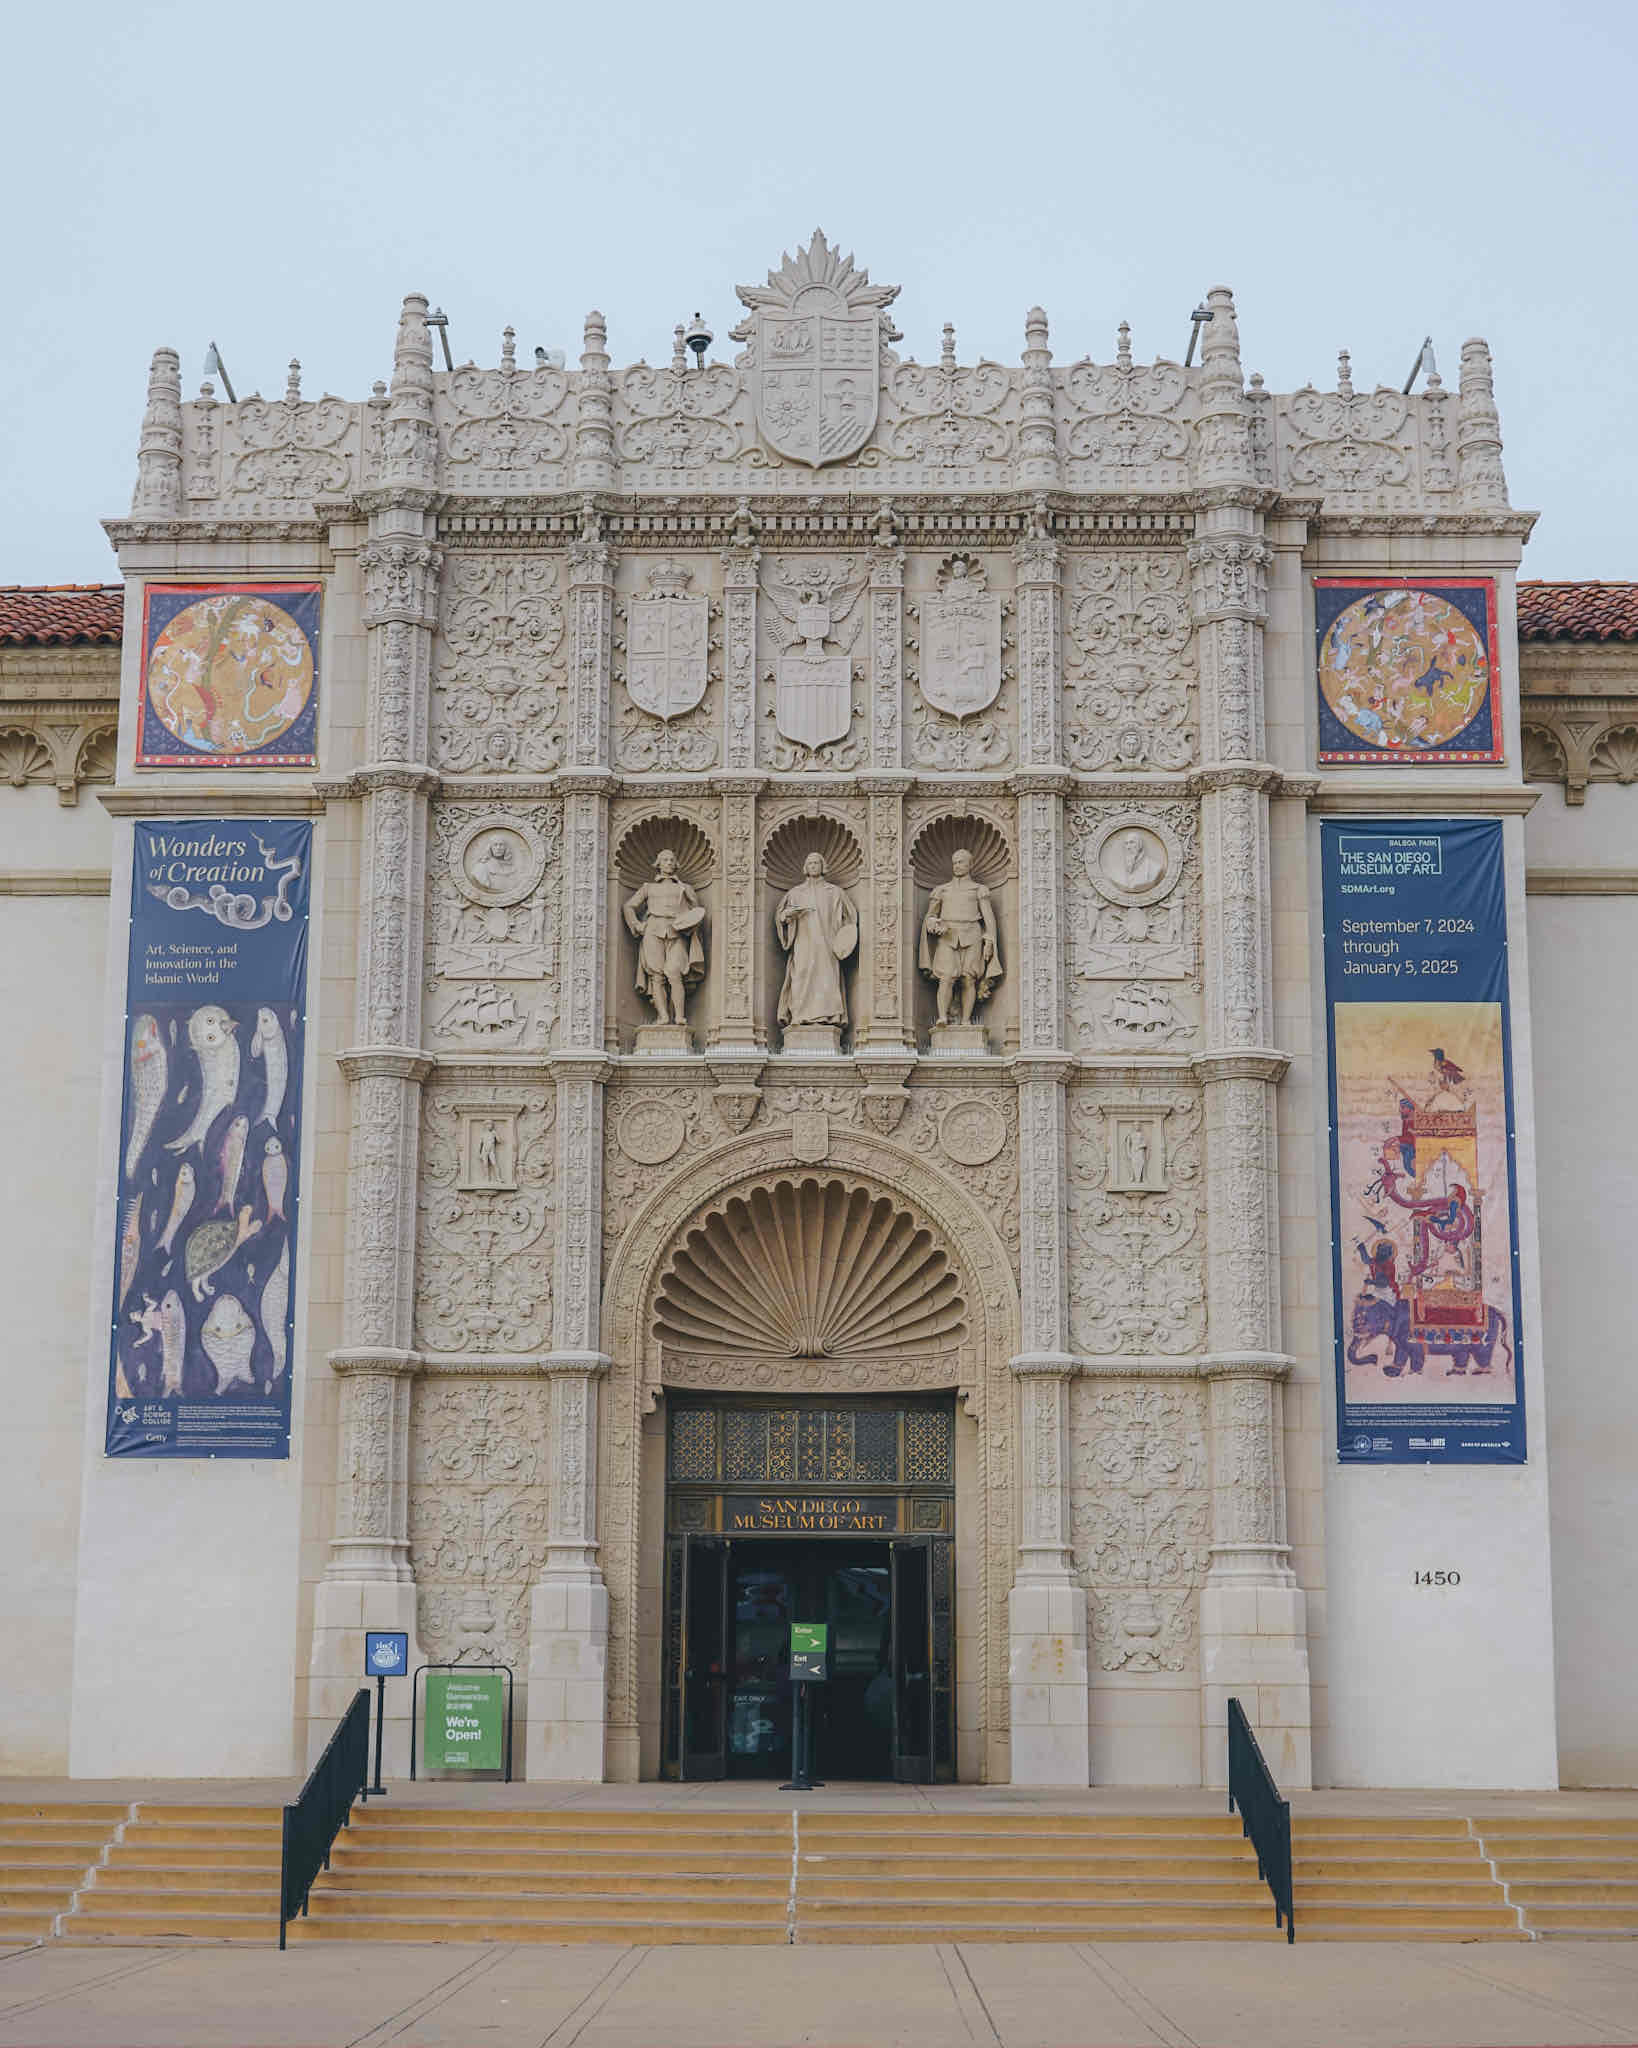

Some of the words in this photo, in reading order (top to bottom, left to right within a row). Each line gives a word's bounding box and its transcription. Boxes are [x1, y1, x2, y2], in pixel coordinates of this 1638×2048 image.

[150, 834, 246, 857] Wonders
[1341, 852, 1364, 863] THE
[1367, 852, 1392, 863] SAN
[1394, 852, 1431, 863] DIEGO
[150, 864, 166, 881] of
[167, 861, 265, 882] Creation
[1340, 864, 1393, 875] MUSEUM
[1395, 864, 1411, 875] OF
[1413, 864, 1436, 875] ART
[1340, 885, 1396, 895] SDMArt.org
[1342, 919, 1420, 936] September
[1424, 919, 1434, 934] 7,
[1438, 919, 1475, 933] 2024
[146, 944, 166, 955] Art,
[169, 943, 214, 955] Science,
[216, 943, 237, 954] and
[1343, 939, 1400, 957] through
[146, 958, 202, 969] Innovation
[205, 958, 216, 969] in
[219, 958, 237, 969] the
[1343, 960, 1401, 976] January
[1405, 960, 1417, 976] 5,
[1421, 960, 1459, 974] 2025
[145, 973, 183, 984] Islamic
[187, 972, 220, 984] World
[759, 1499, 798, 1513] SAN
[802, 1499, 862, 1513] DIEGO
[734, 1514, 815, 1529] MUSEUM
[819, 1514, 846, 1529] OF
[848, 1514, 887, 1529] ART
[1414, 1571, 1461, 1586] 1450
[446, 1716, 480, 1728] We're
[446, 1729, 481, 1742] Open!
